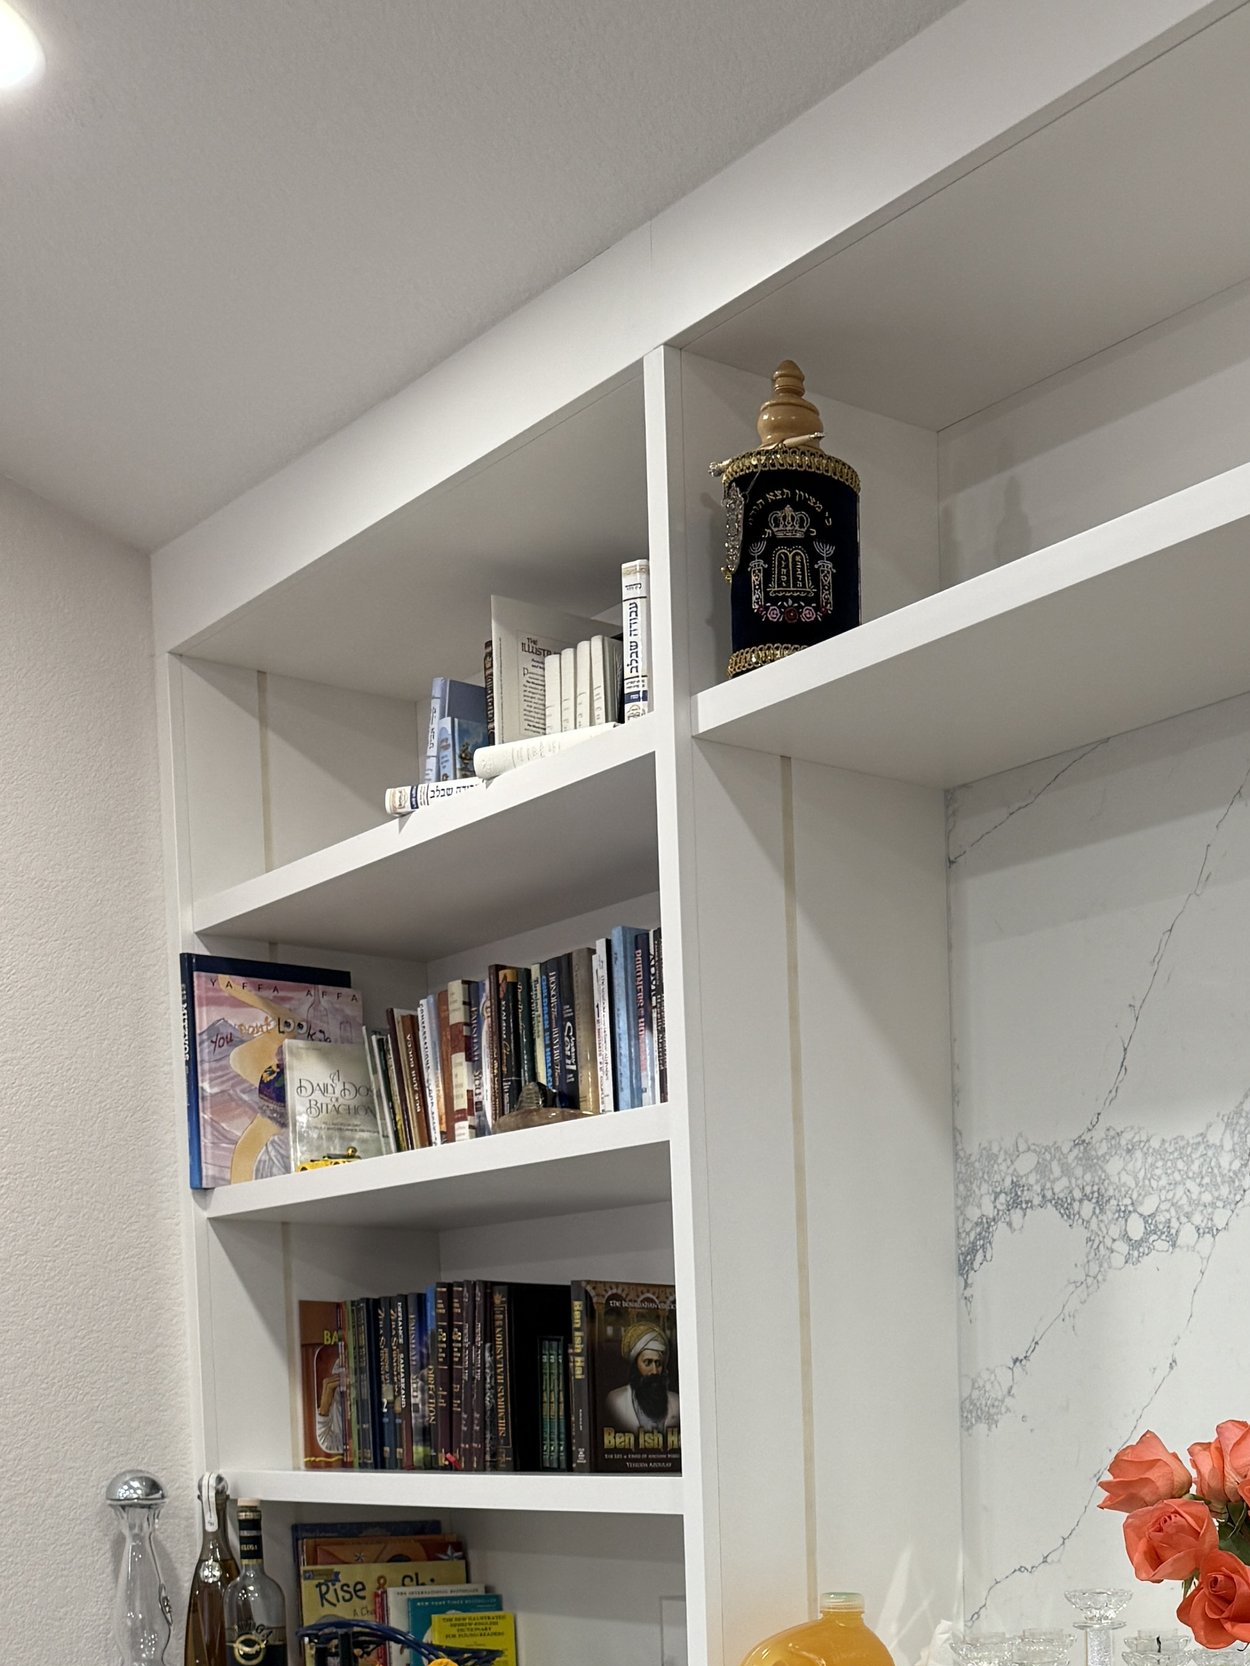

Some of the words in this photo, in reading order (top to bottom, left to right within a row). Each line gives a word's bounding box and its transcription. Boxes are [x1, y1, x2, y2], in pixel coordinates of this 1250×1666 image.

[210, 979, 280, 994] YAFFA
[306, 989, 358, 1002] AFFA
[603, 1427, 636, 1450] Ben
[639, 1426, 664, 1450] Ish
[316, 1580, 366, 1608] Rise
